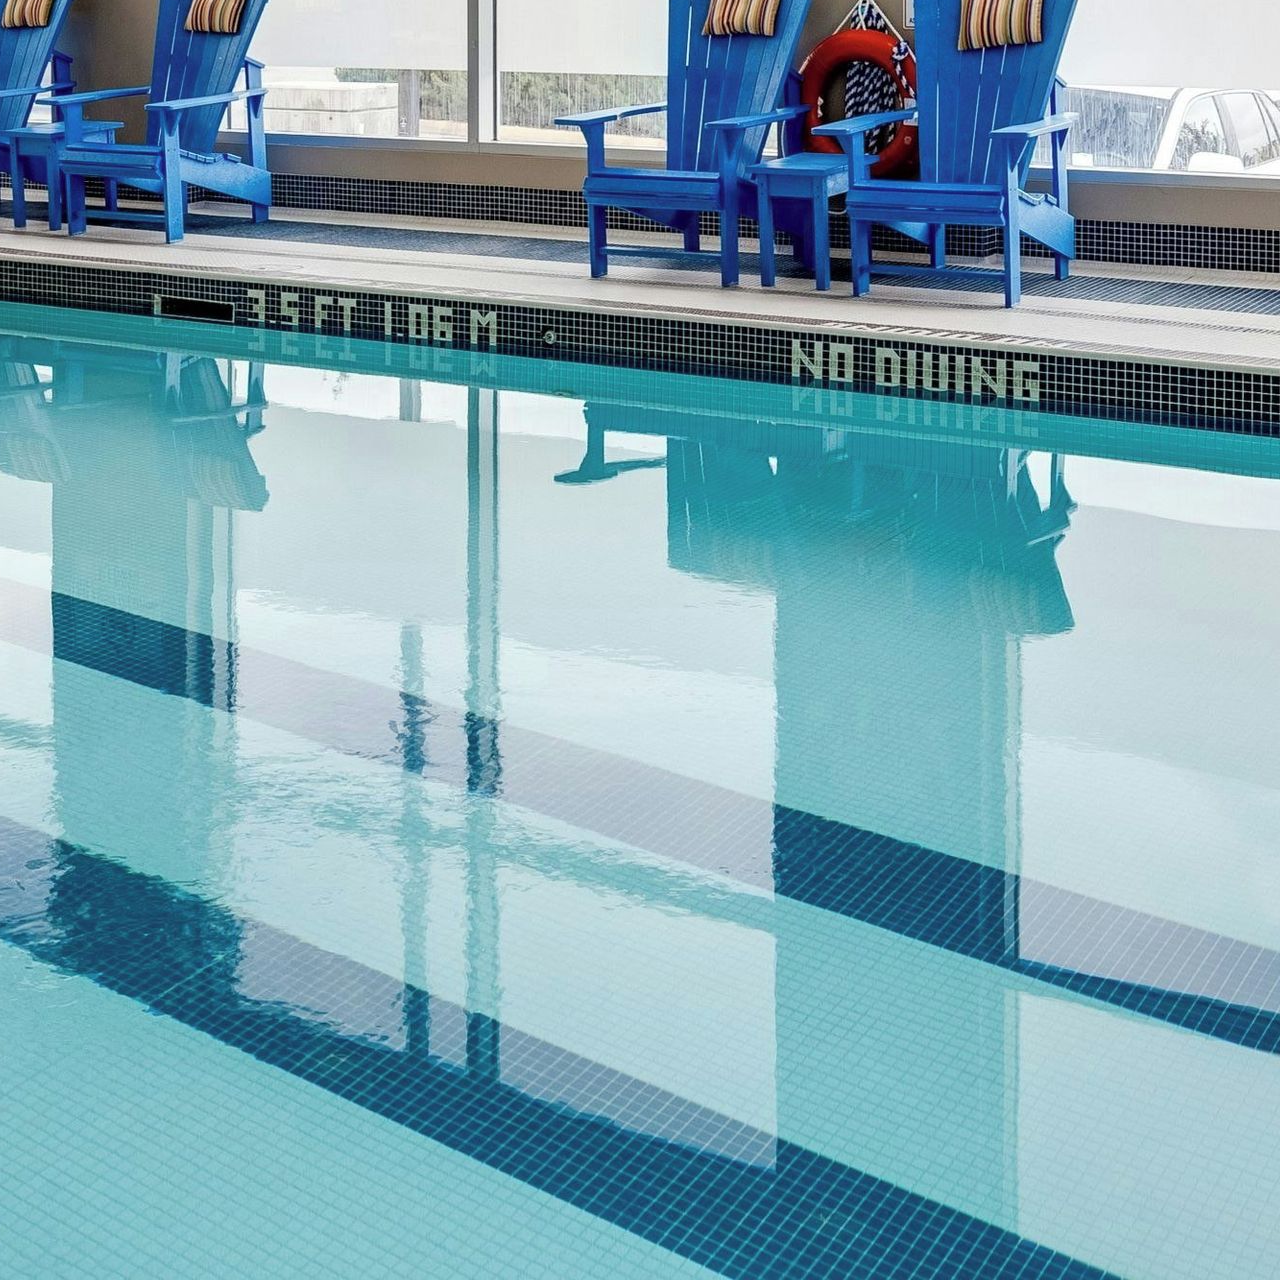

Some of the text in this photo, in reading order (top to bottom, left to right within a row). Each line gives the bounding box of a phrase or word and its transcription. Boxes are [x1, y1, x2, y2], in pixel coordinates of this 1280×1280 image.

[315, 295, 356, 331] FT
[470, 309, 497, 346] M
[791, 339, 1039, 402] NO DIVING
